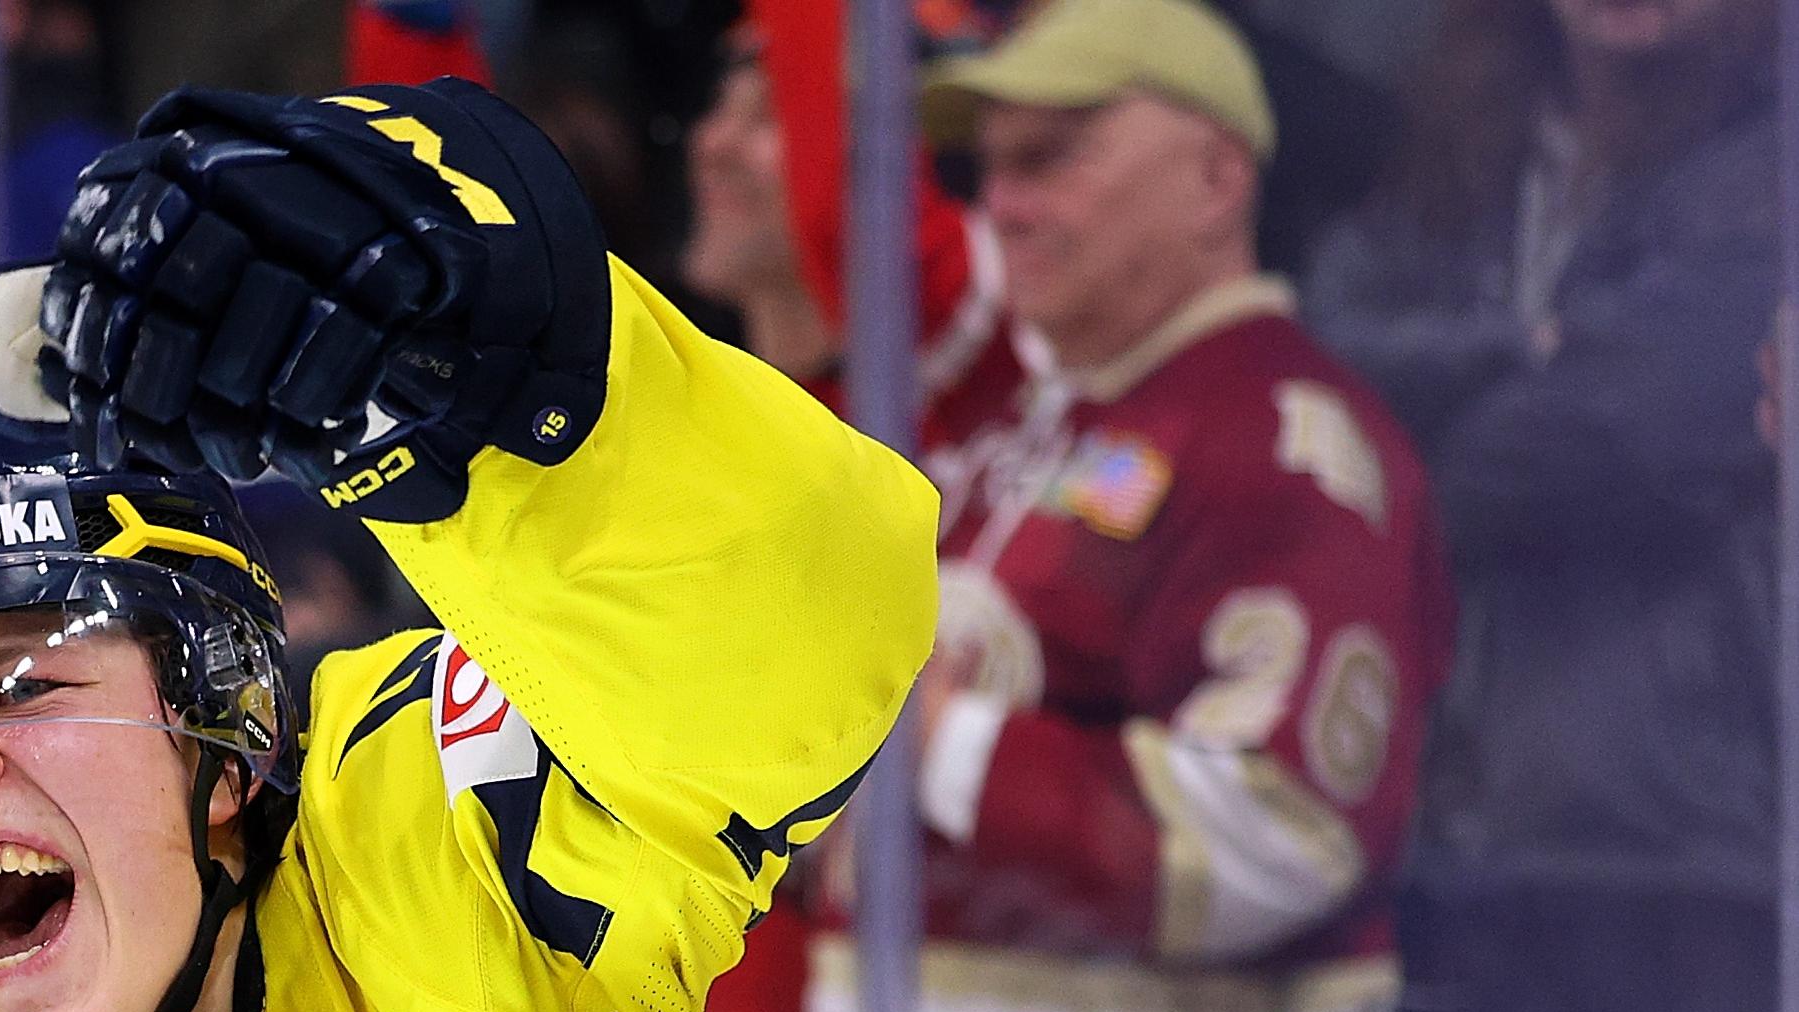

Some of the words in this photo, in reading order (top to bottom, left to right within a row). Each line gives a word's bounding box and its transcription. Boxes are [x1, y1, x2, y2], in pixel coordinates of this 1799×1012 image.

[541, 411, 566, 437] 15
[320, 446, 416, 508] CCM
[251, 561, 282, 606] CC
[245, 718, 271, 749] CCM
